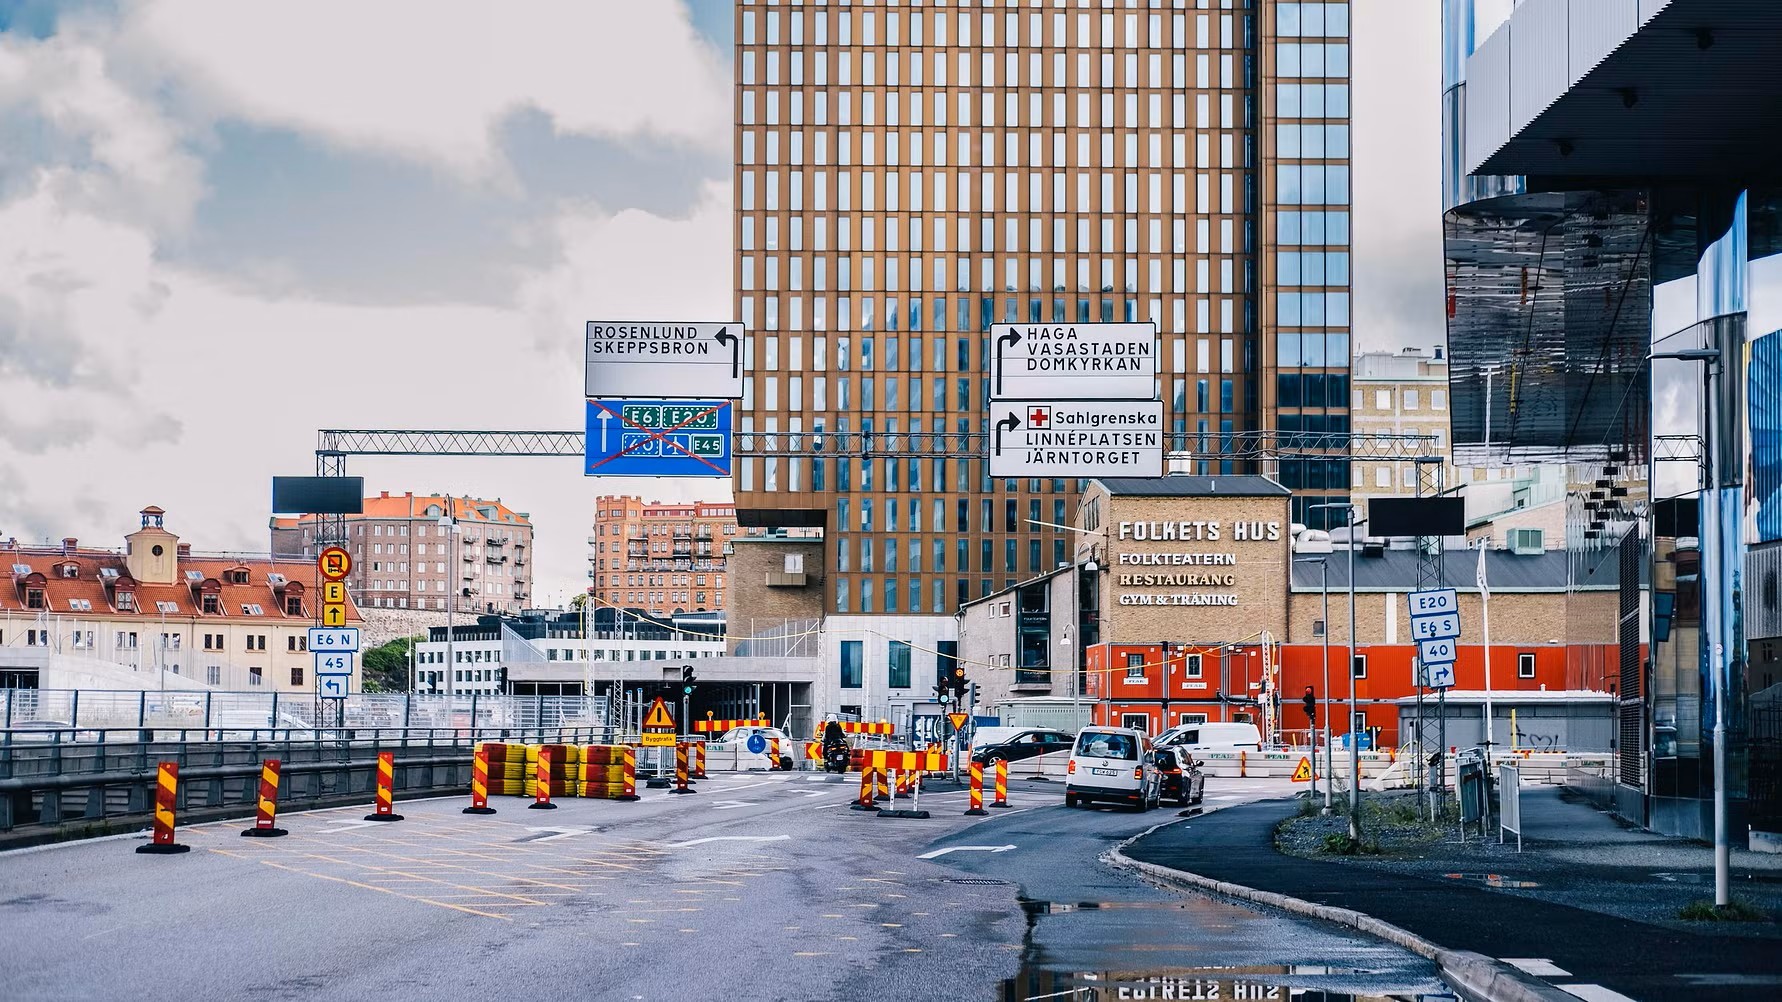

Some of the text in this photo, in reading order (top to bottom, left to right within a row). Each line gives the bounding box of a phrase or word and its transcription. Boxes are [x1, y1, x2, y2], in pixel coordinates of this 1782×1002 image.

[594, 326, 697, 339] ROSENLUND
[1027, 327, 1078, 340] HAGA
[594, 341, 708, 355] SKEPPSBRON
[1027, 342, 1150, 355] VASASTADEN
[1027, 358, 1141, 371] DOMKYRKAN
[631, 410, 653, 424] E6
[672, 411, 708, 424] E20
[1055, 411, 1157, 427] Sahlgrenska
[1026, 430, 1156, 446] LINNÉPLATSEN
[694, 439, 720, 451] E45
[1025, 448, 1140, 464] JÄRNTORGET
[1119, 521, 1280, 541] FOLKETS HUS
[1119, 553, 1236, 565] FOLKTEATERN
[1119, 573, 1235, 586] RESTAURANG
[330, 586, 338, 599] E
[1119, 592, 1238, 606] GYM & TRÄNING
[1419, 596, 1447, 609] E20
[1420, 620, 1452, 634] E6 S
[317, 634, 350, 645] E6 N
[1429, 644, 1448, 657] 40
[325, 657, 344, 669] 45
